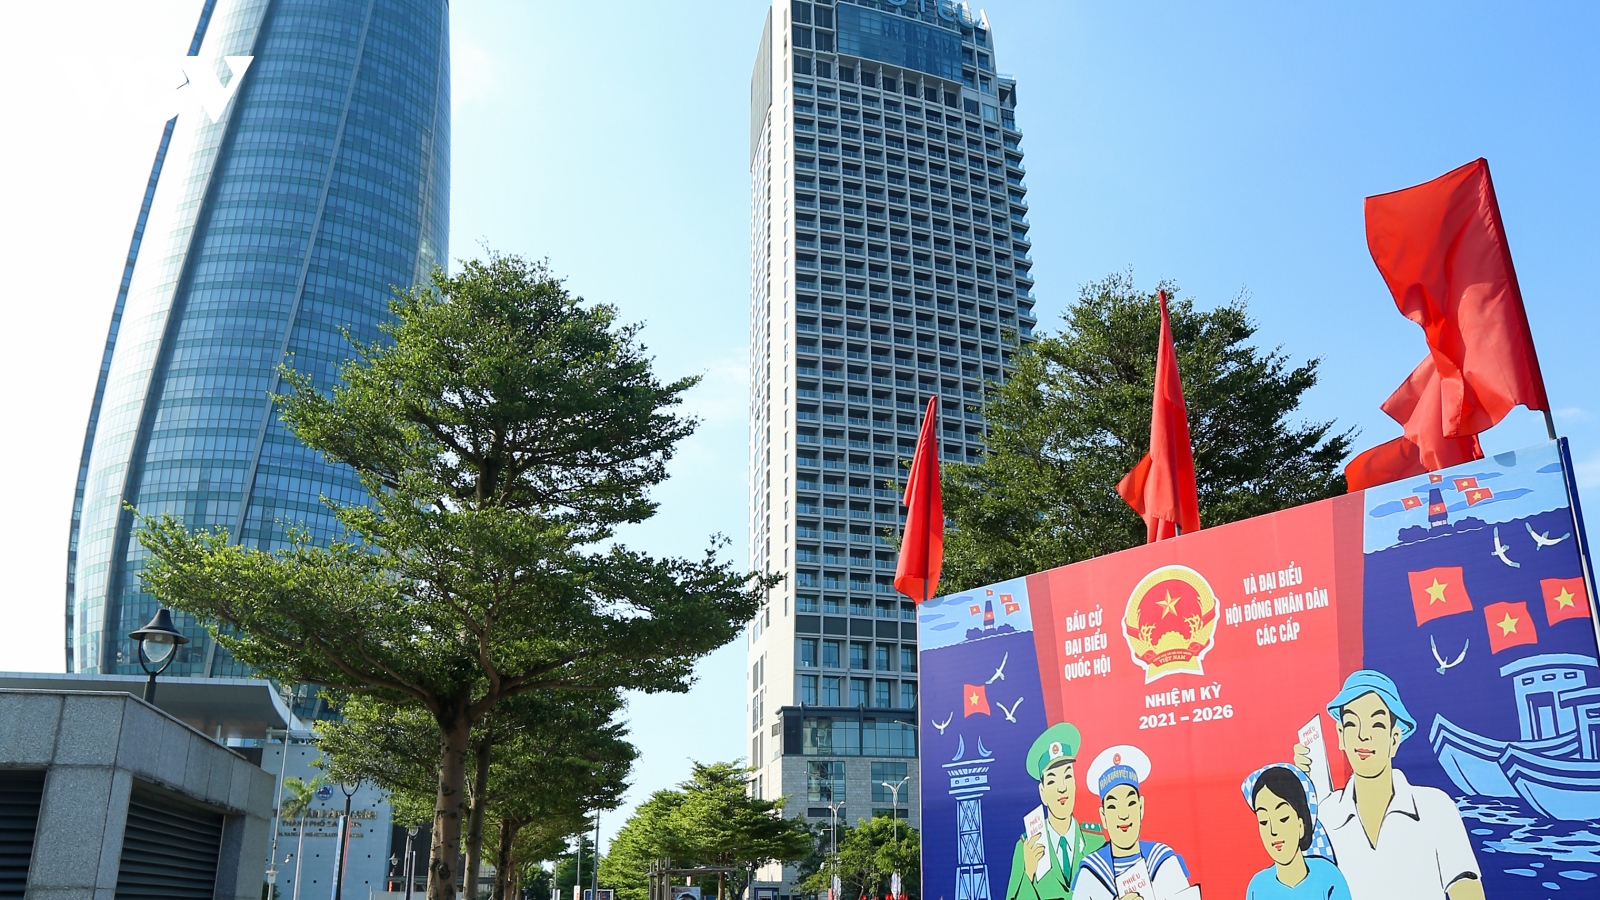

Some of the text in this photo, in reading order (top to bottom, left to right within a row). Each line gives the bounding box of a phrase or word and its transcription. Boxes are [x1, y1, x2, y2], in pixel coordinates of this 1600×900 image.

[1243, 560, 1303, 595] VÀ ĐẠI BIỂU
[1066, 604, 1103, 633] BẦU CỬ
[1225, 586, 1329, 628] HỘI ĐỒNG NHÂN DÂN
[1065, 628, 1108, 658] ĐẠI BIỂU
[1256, 616, 1301, 647] CÁC CẤP
[1064, 654, 1111, 682] QUỐC HỘI
[1145, 681, 1222, 709] NHIỆM KỲ
[1139, 711, 1177, 730] 2021
[1192, 704, 1234, 723] 2026
